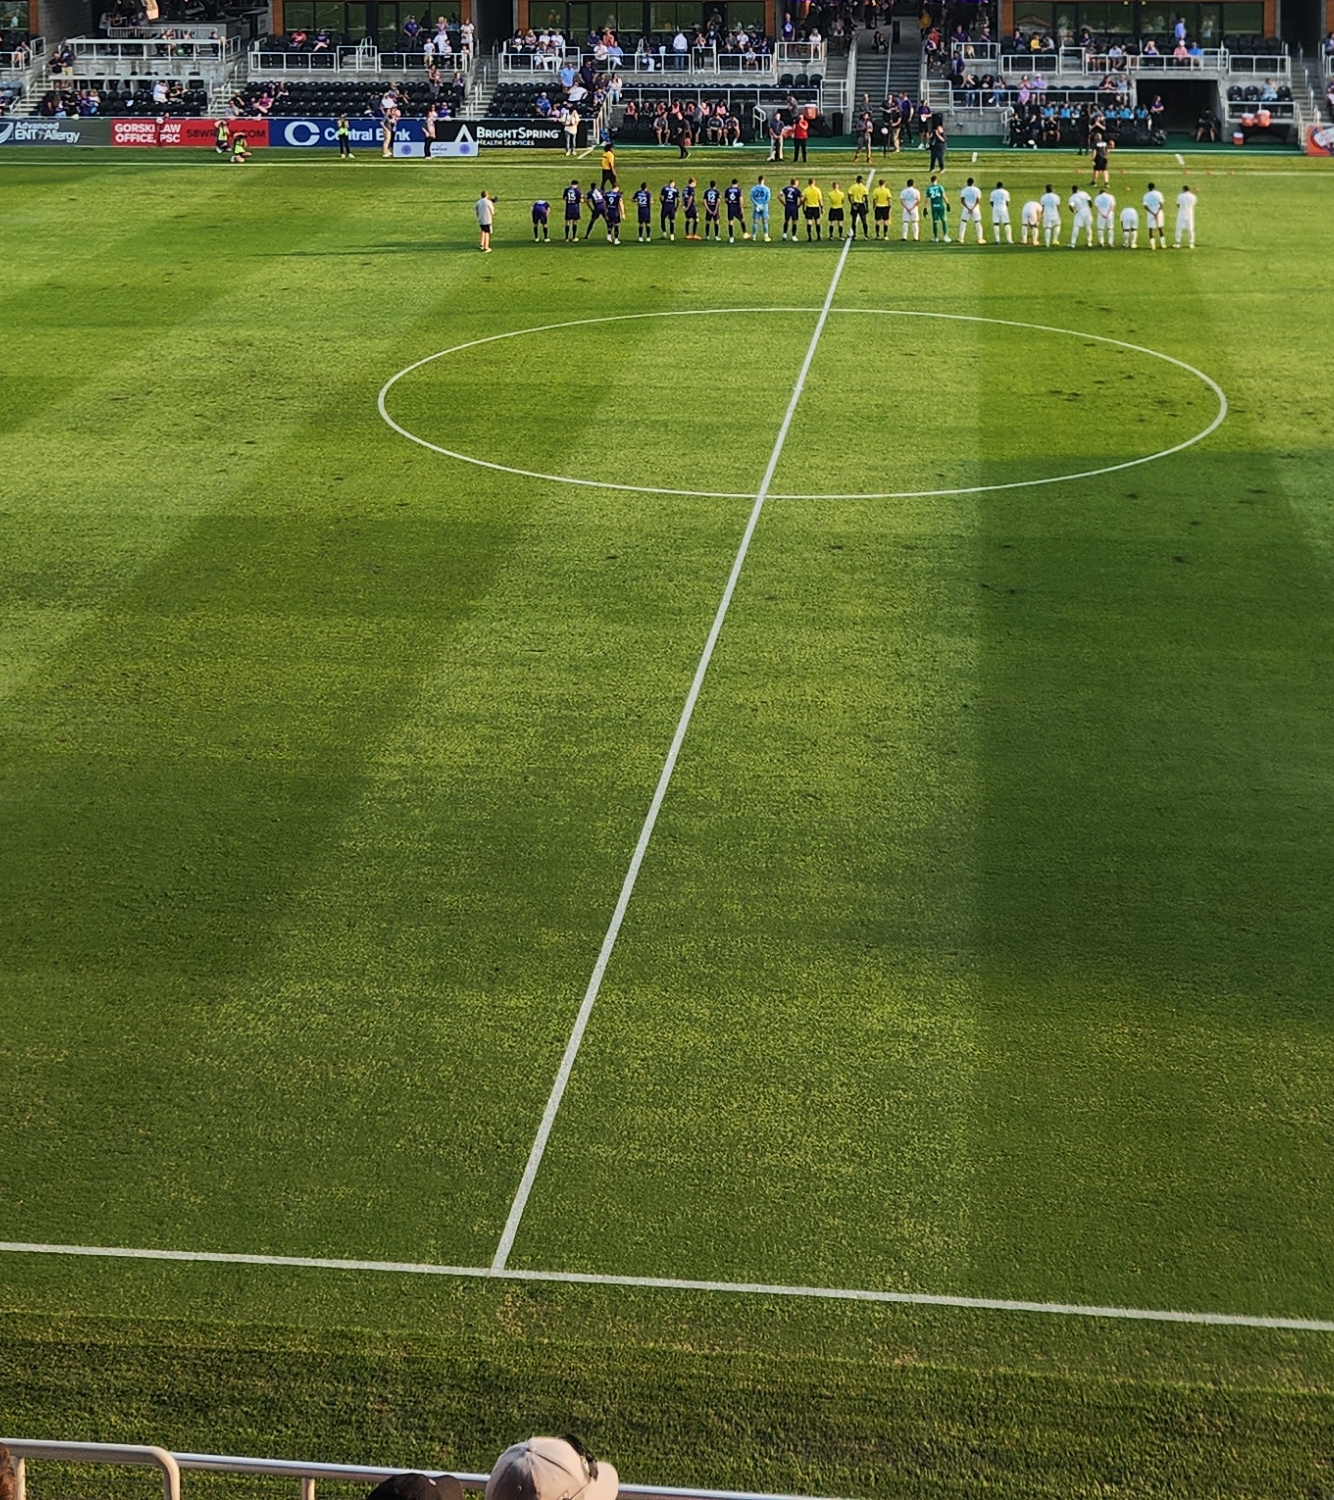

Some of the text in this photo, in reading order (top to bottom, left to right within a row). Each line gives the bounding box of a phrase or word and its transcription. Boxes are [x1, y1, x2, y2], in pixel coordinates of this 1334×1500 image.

[15, 122, 59, 130] Advanced
[115, 123, 156, 133] GORSKI
[15, 130, 38, 140] ENT
[43, 130, 80, 143] Allergy
[116, 133, 181, 143] OFFICE, PSC
[375, 127, 410, 141] Bnk
[608, 197, 615, 205] 9
[729, 192, 736, 201] 6
